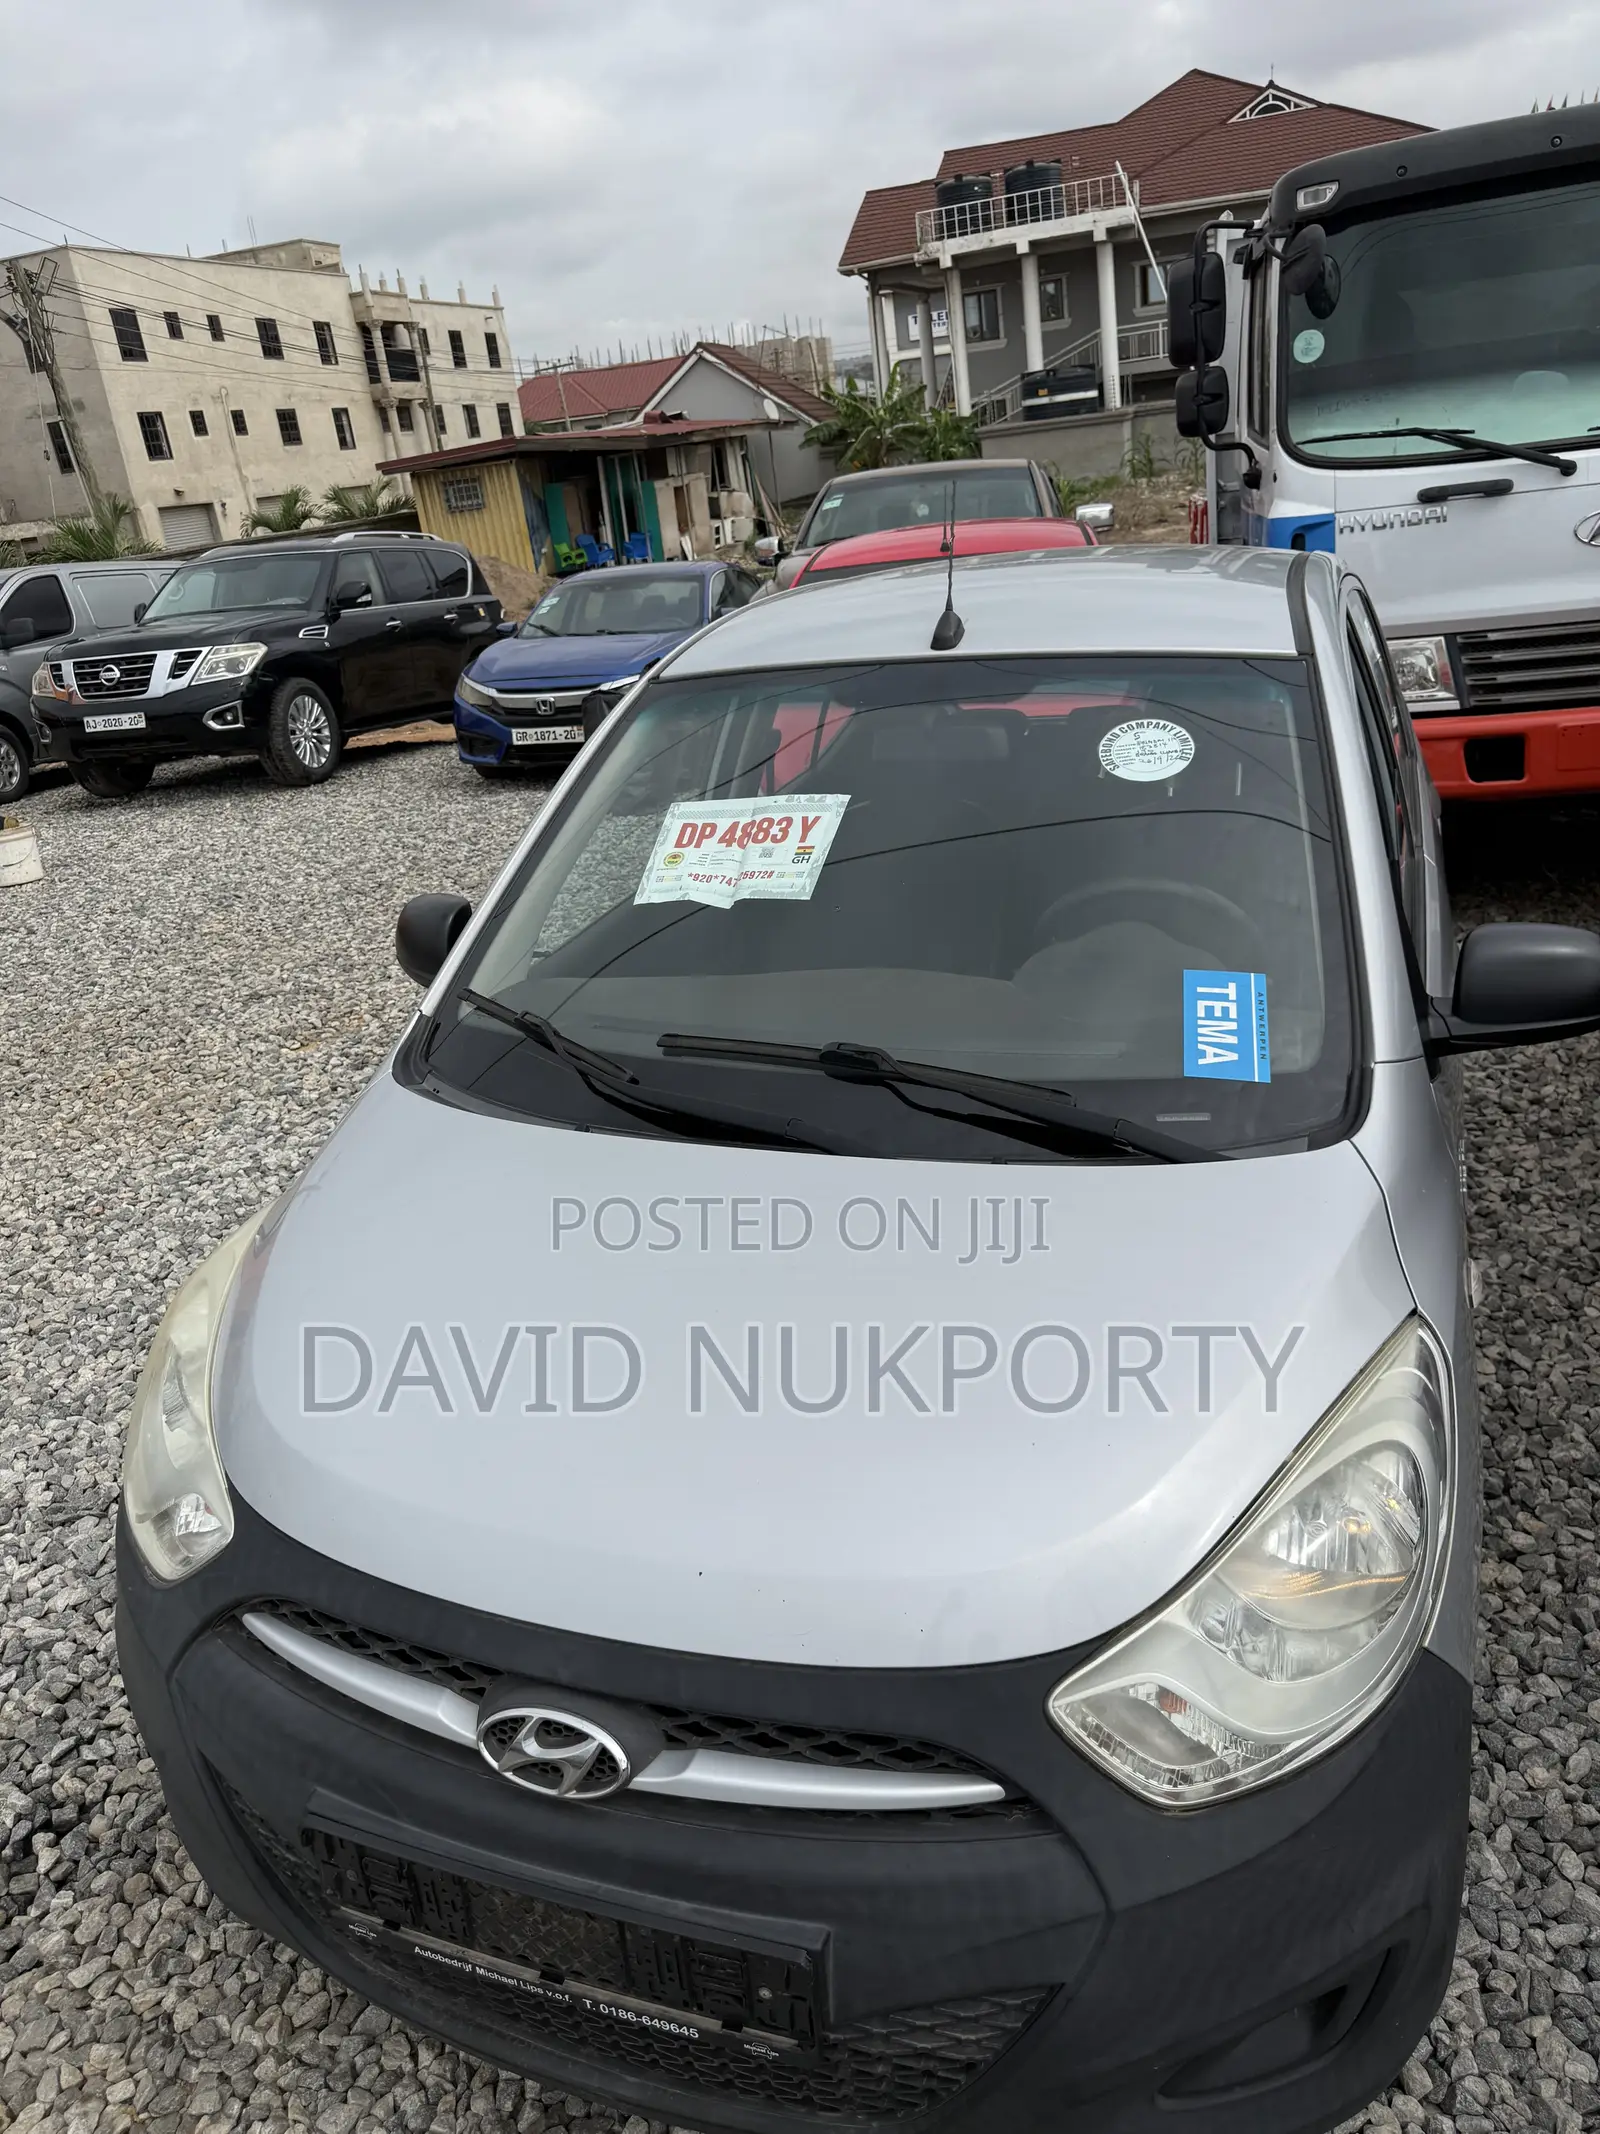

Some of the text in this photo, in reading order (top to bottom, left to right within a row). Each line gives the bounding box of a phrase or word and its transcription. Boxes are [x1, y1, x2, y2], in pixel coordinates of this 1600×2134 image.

[1339, 505, 1448, 535] HYUNDAI
[1100, 731, 1120, 772] SAFEBOND
[1118, 721, 1177, 734] COMPANY
[1173, 730, 1193, 762] LIMITED
[673, 815, 822, 850] DP 4883 Y
[791, 855, 811, 864] GH
[1196, 981, 1239, 1065] TEMA
[1257, 991, 1267, 1060] ANTWERPEN
[414, 1945, 700, 2039] Autobedrijf Michael Lips v.o.f. T. 0186-649645
[743, 2043, 767, 2054] Michael
